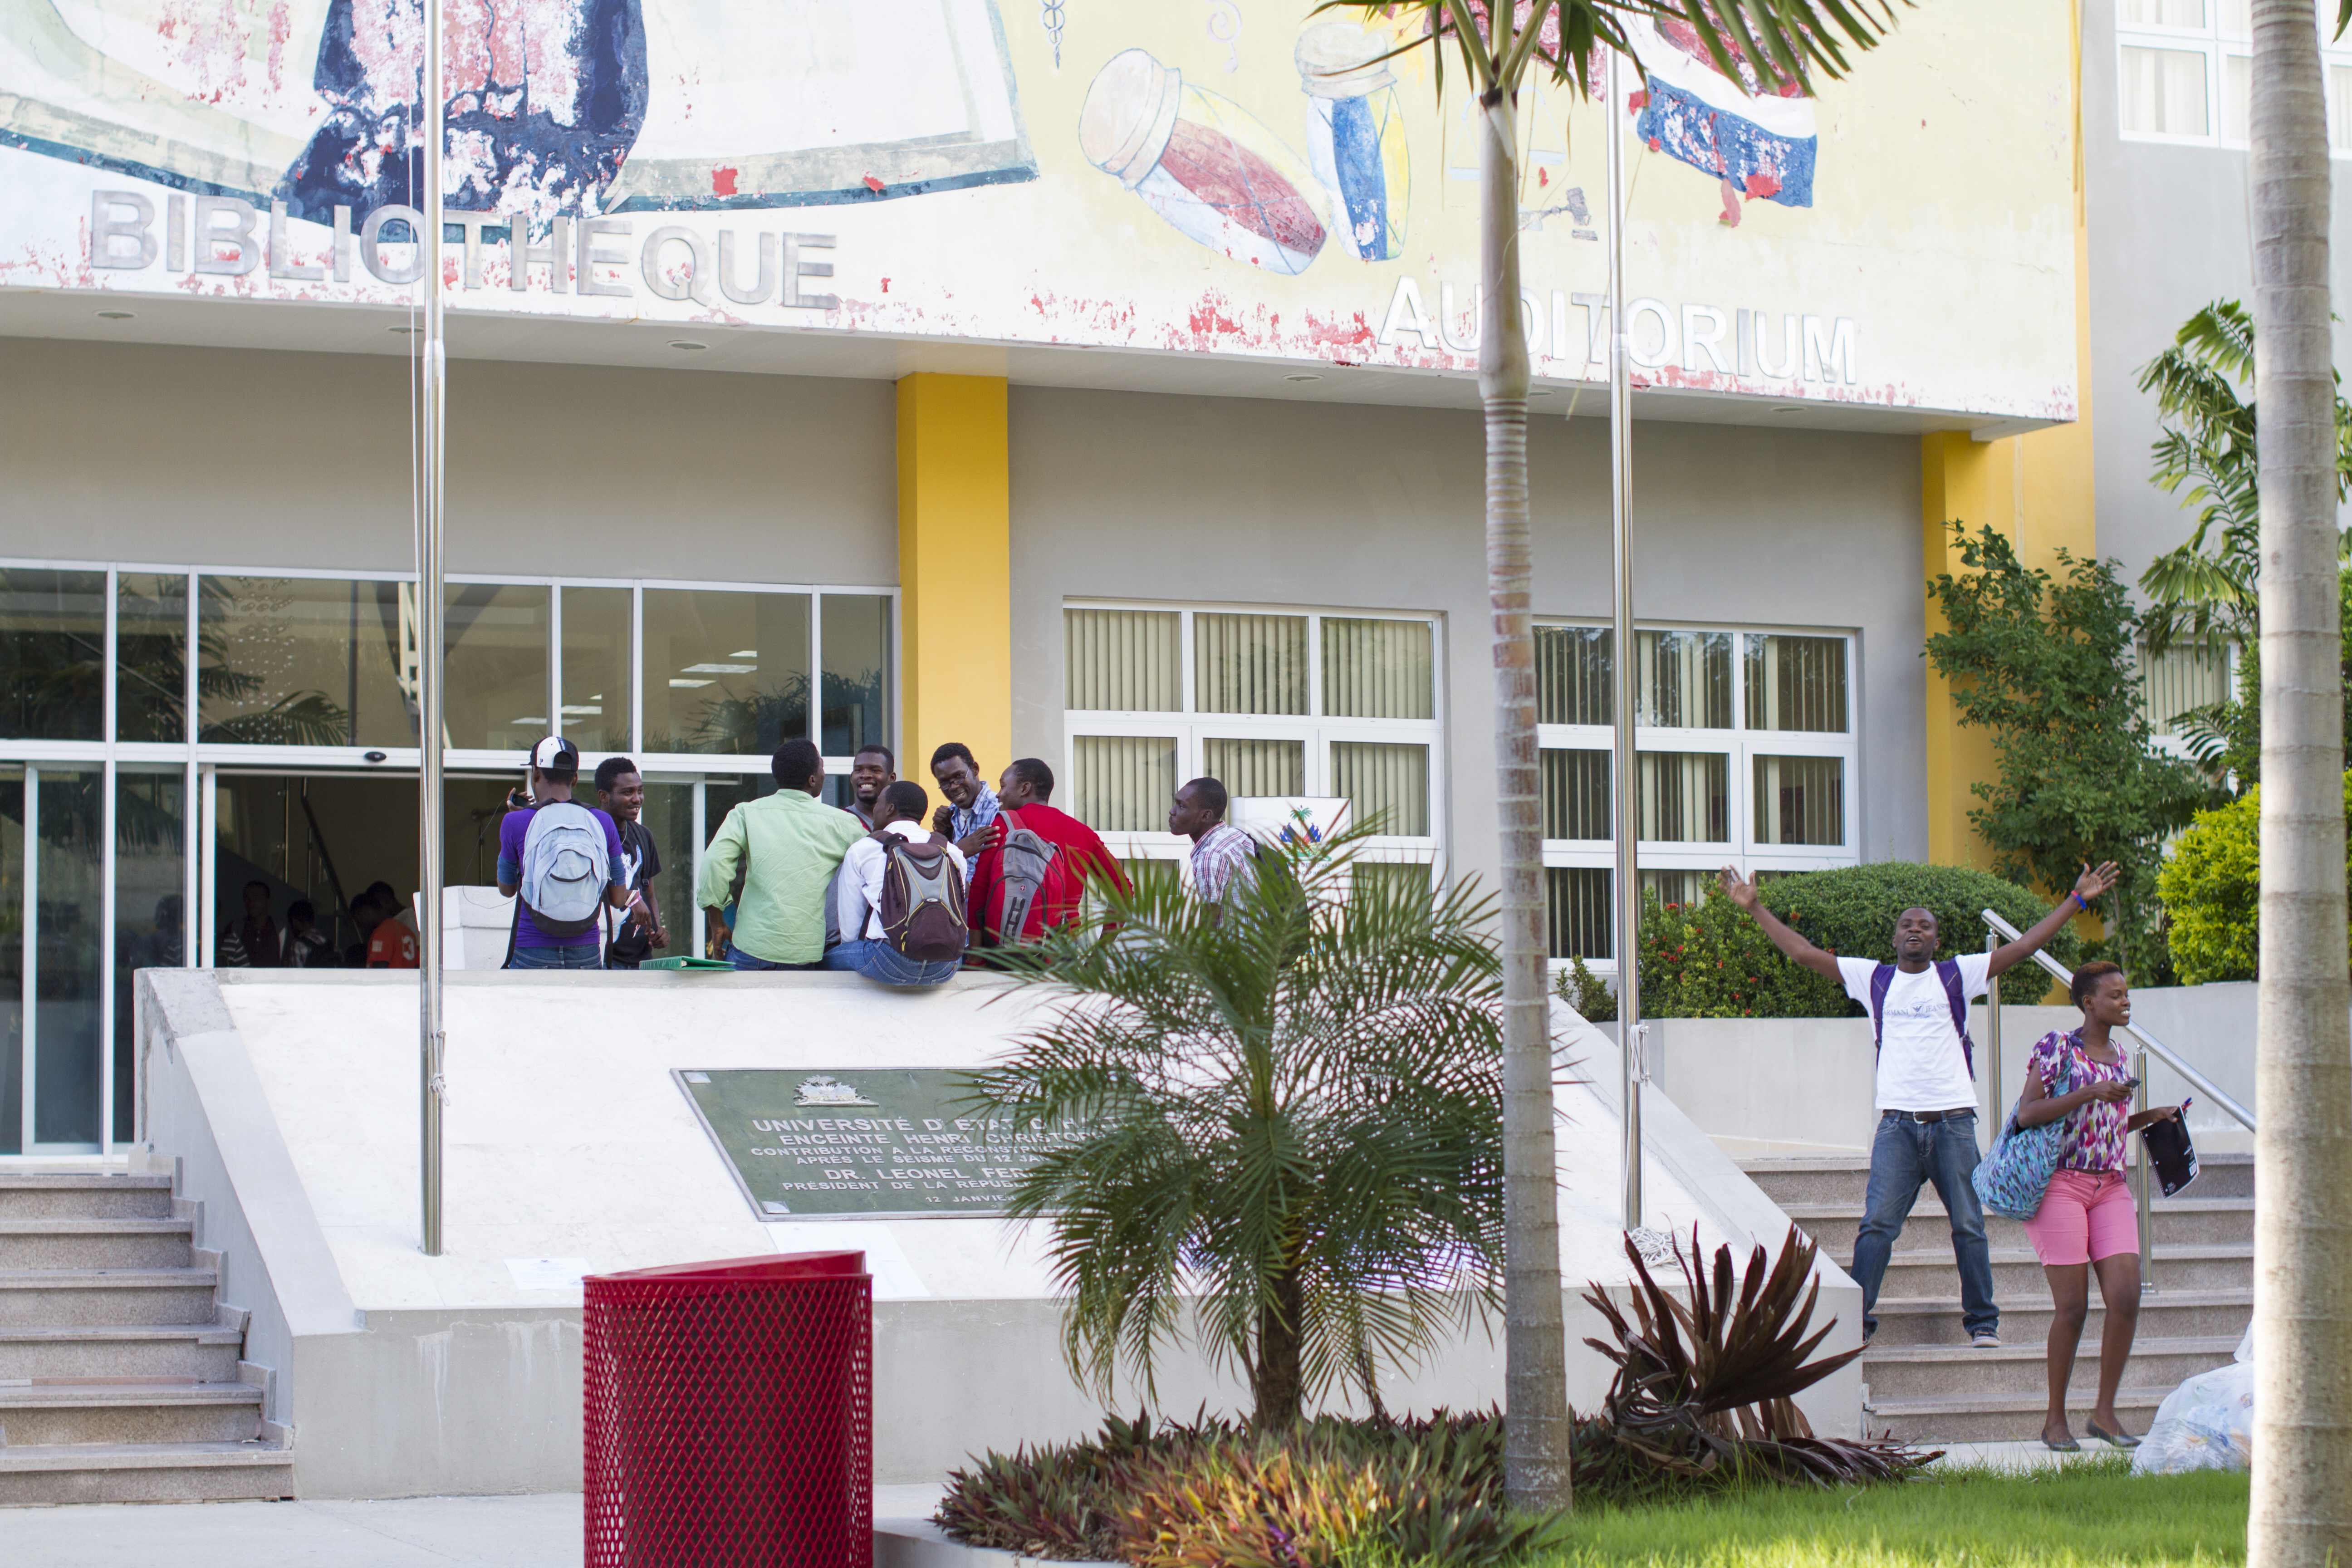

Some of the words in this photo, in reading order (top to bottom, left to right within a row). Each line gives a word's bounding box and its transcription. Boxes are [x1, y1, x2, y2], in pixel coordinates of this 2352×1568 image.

[91, 189, 837, 310] BIBLIOTHEQUE
[752, 1116, 914, 1132] UNIVERSITÉ
[954, 1117, 1014, 1131] ÉTAT
[779, 1134, 891, 1146] ENCEINTE
[903, 1133, 971, 1144] HENRI
[985, 1132, 1107, 1144] CHRISTOPH
[751, 1147, 883, 1156] CONTRIBUTION
[909, 1146, 935, 1154] LA
[823, 1169, 866, 1180] DR.
[876, 1168, 970, 1179] LEONEL
[953, 1194, 1016, 1202] JANVIER
